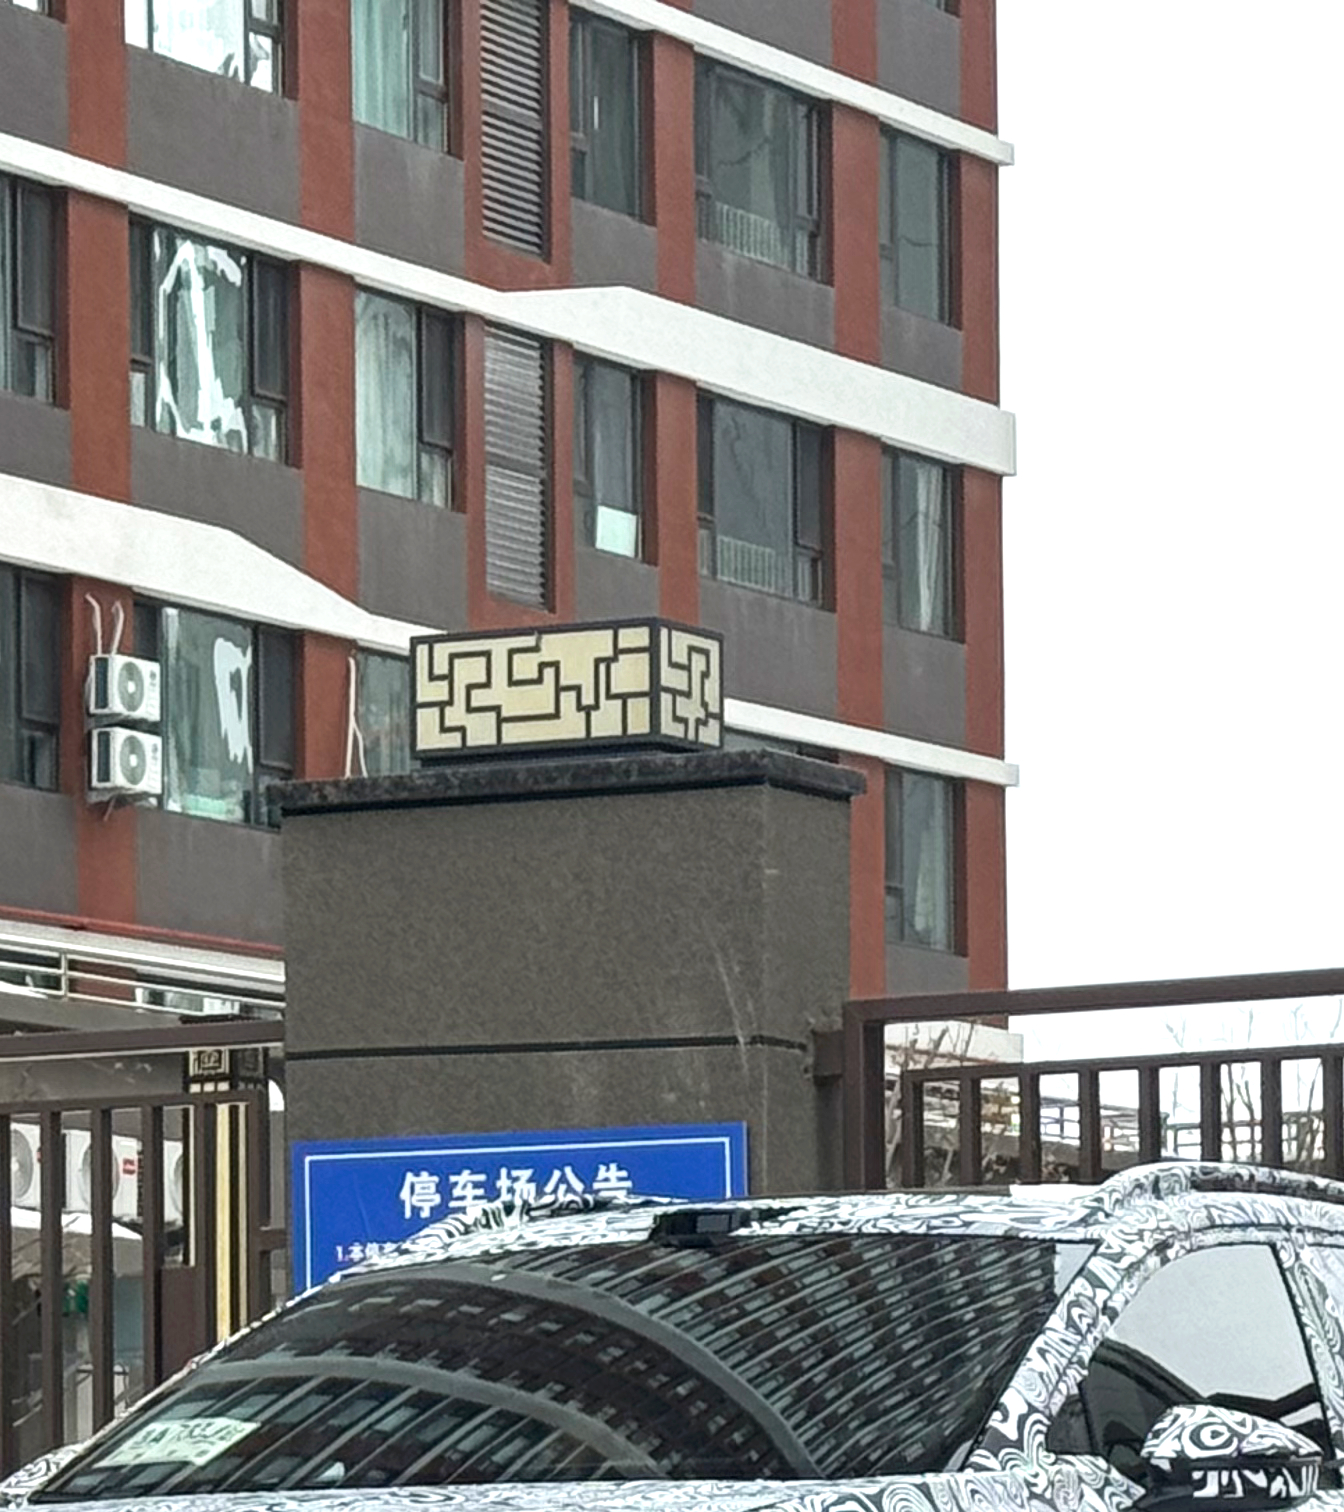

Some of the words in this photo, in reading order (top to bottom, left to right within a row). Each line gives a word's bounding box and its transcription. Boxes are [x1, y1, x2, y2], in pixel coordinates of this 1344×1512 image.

[399, 1163, 633, 1219] 停车场公告
